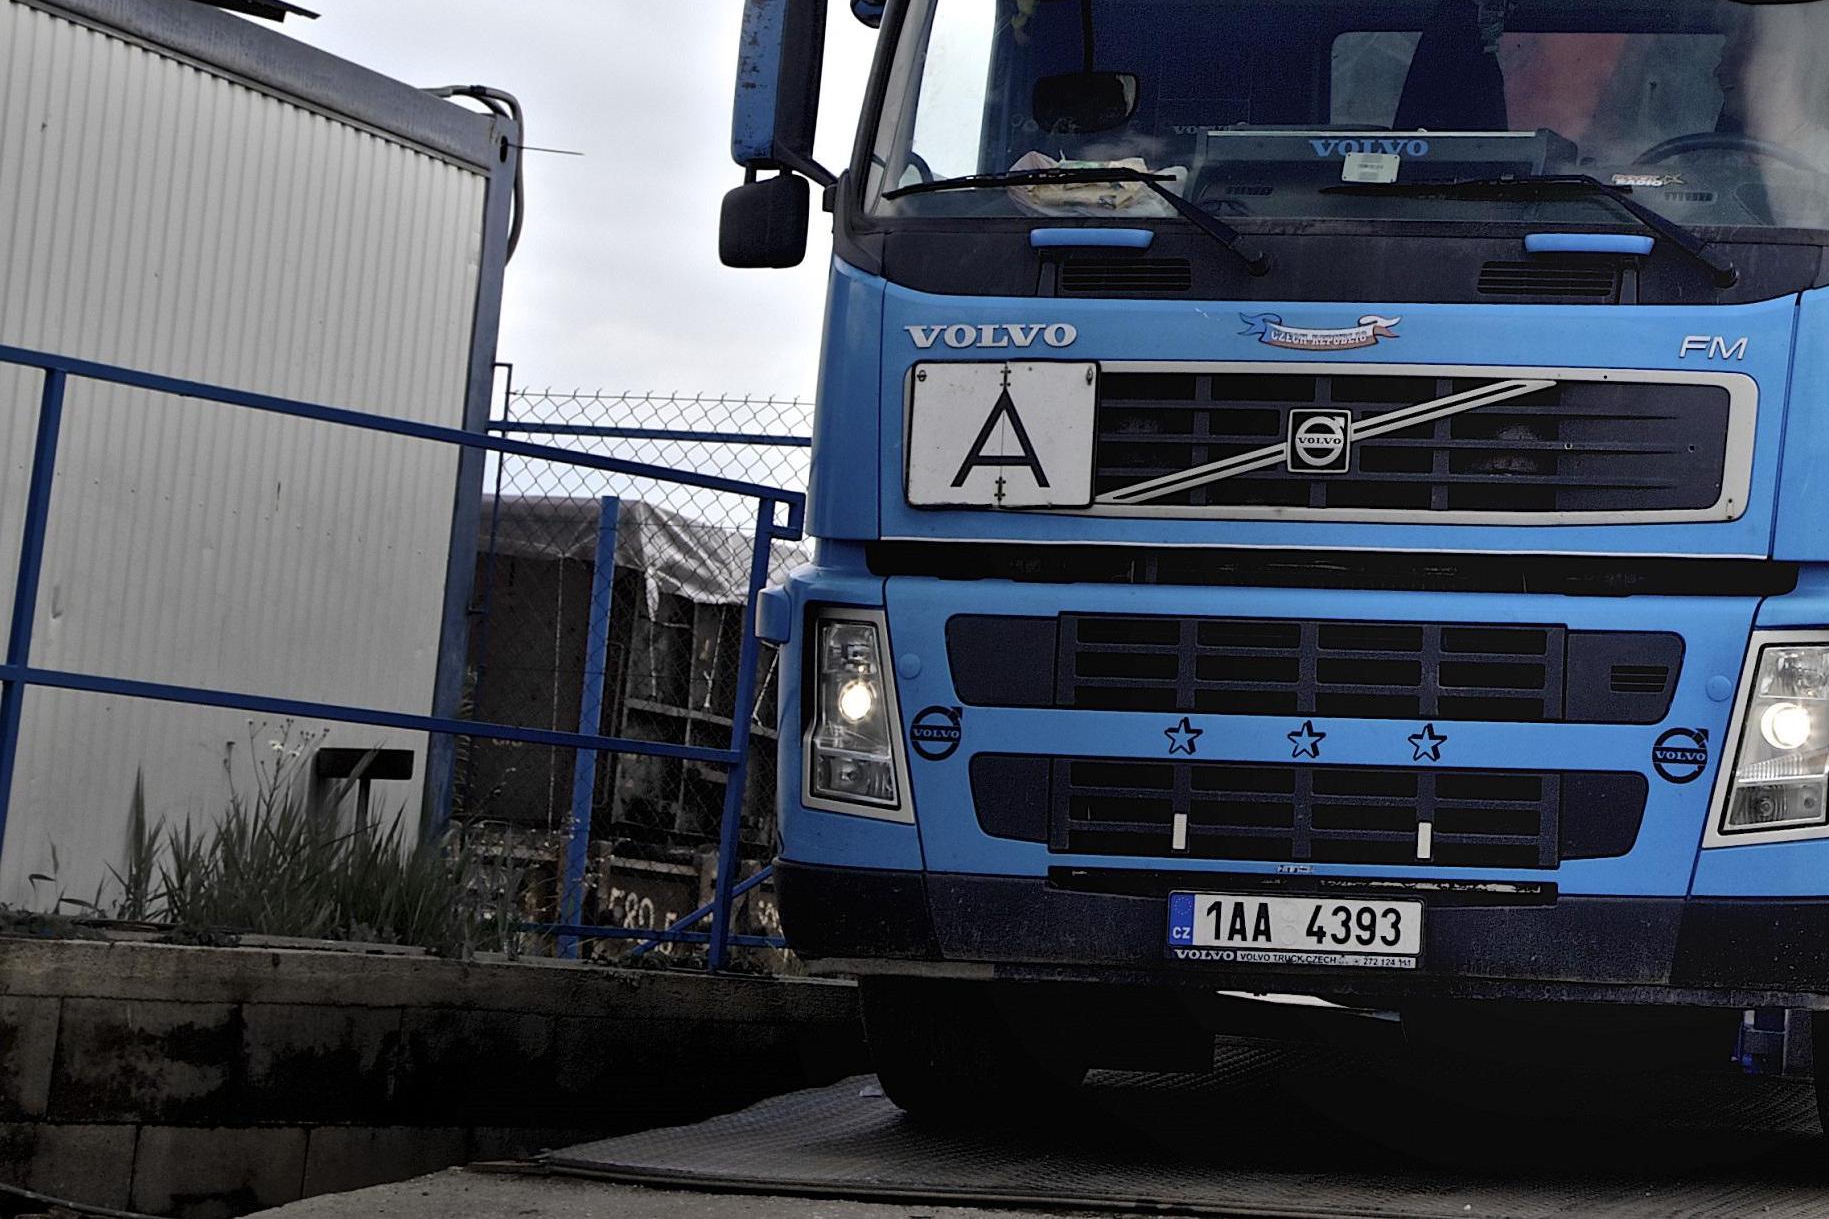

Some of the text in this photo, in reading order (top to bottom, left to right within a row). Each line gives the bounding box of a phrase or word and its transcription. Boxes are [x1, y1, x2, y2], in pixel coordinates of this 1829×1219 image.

[1309, 139, 1429, 158] VOLVO
[903, 324, 1078, 349] VOLVO
[1271, 330, 1308, 344] CZECH
[1679, 335, 1749, 360] FM
[950, 386, 1050, 488] A
[1297, 436, 1343, 447] VOLVO
[913, 728, 960, 738] VOLVO
[1655, 750, 1706, 761] VOLVO
[1172, 900, 1402, 946] CZ 1AA 4393
[1174, 949, 1234, 961] VOLVO
[1240, 953, 1271, 962] VOLVO
